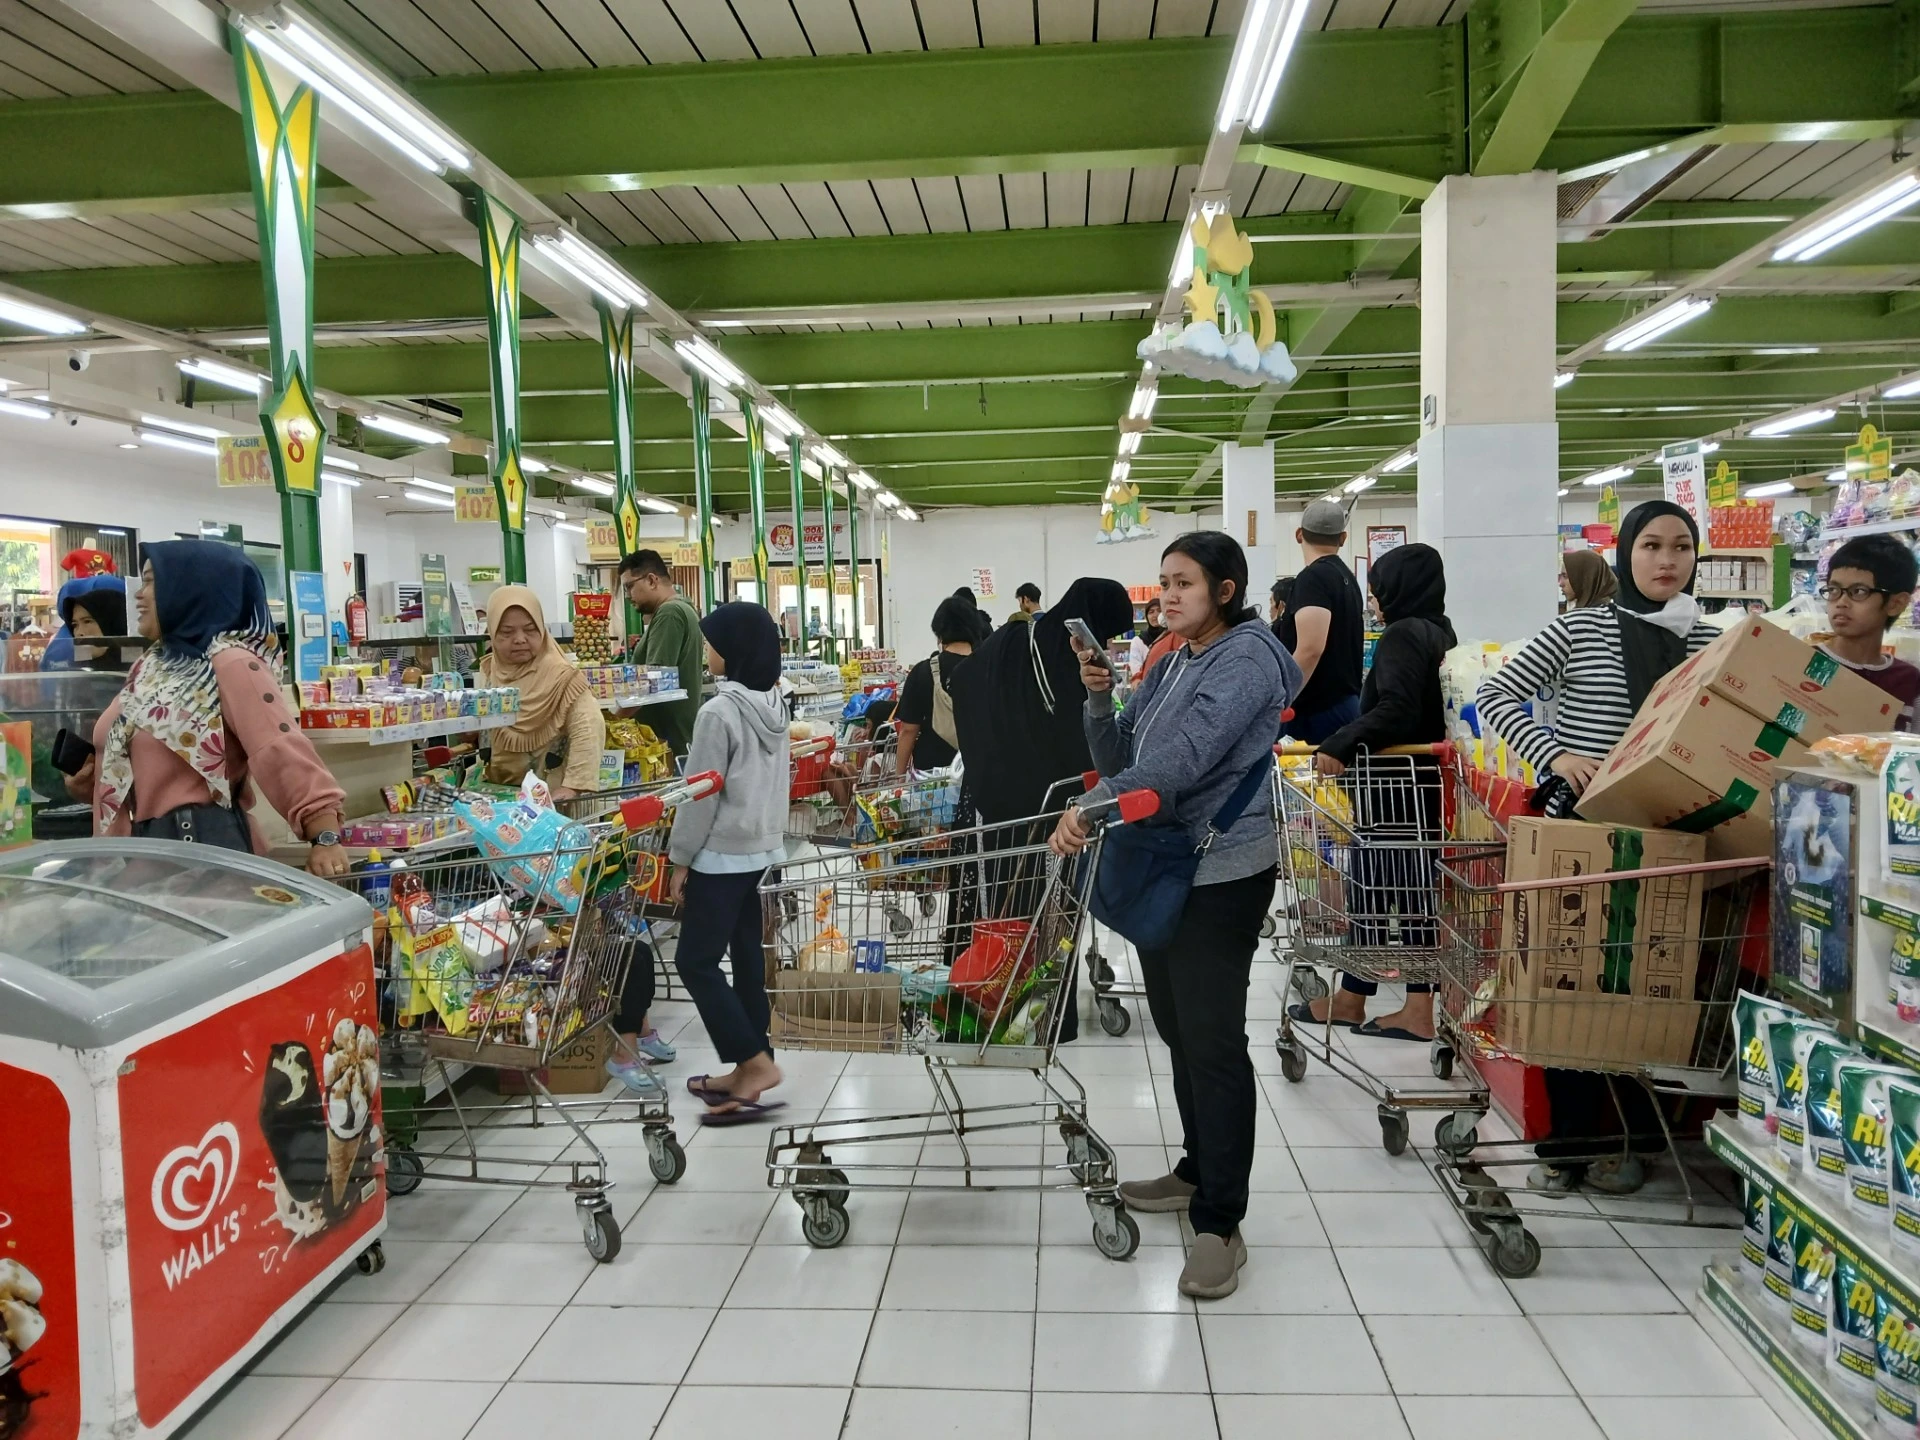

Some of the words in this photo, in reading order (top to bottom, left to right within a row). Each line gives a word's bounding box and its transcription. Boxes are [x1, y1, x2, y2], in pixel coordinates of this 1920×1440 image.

[507, 478, 516, 502] 7
[458, 496, 494, 518] 107
[589, 527, 617, 545] 106
[625, 515, 632, 540] 6
[1724, 675, 1745, 690] XL2
[1672, 744, 1692, 760] XL2
[161, 1209, 241, 1292] WALL'S
